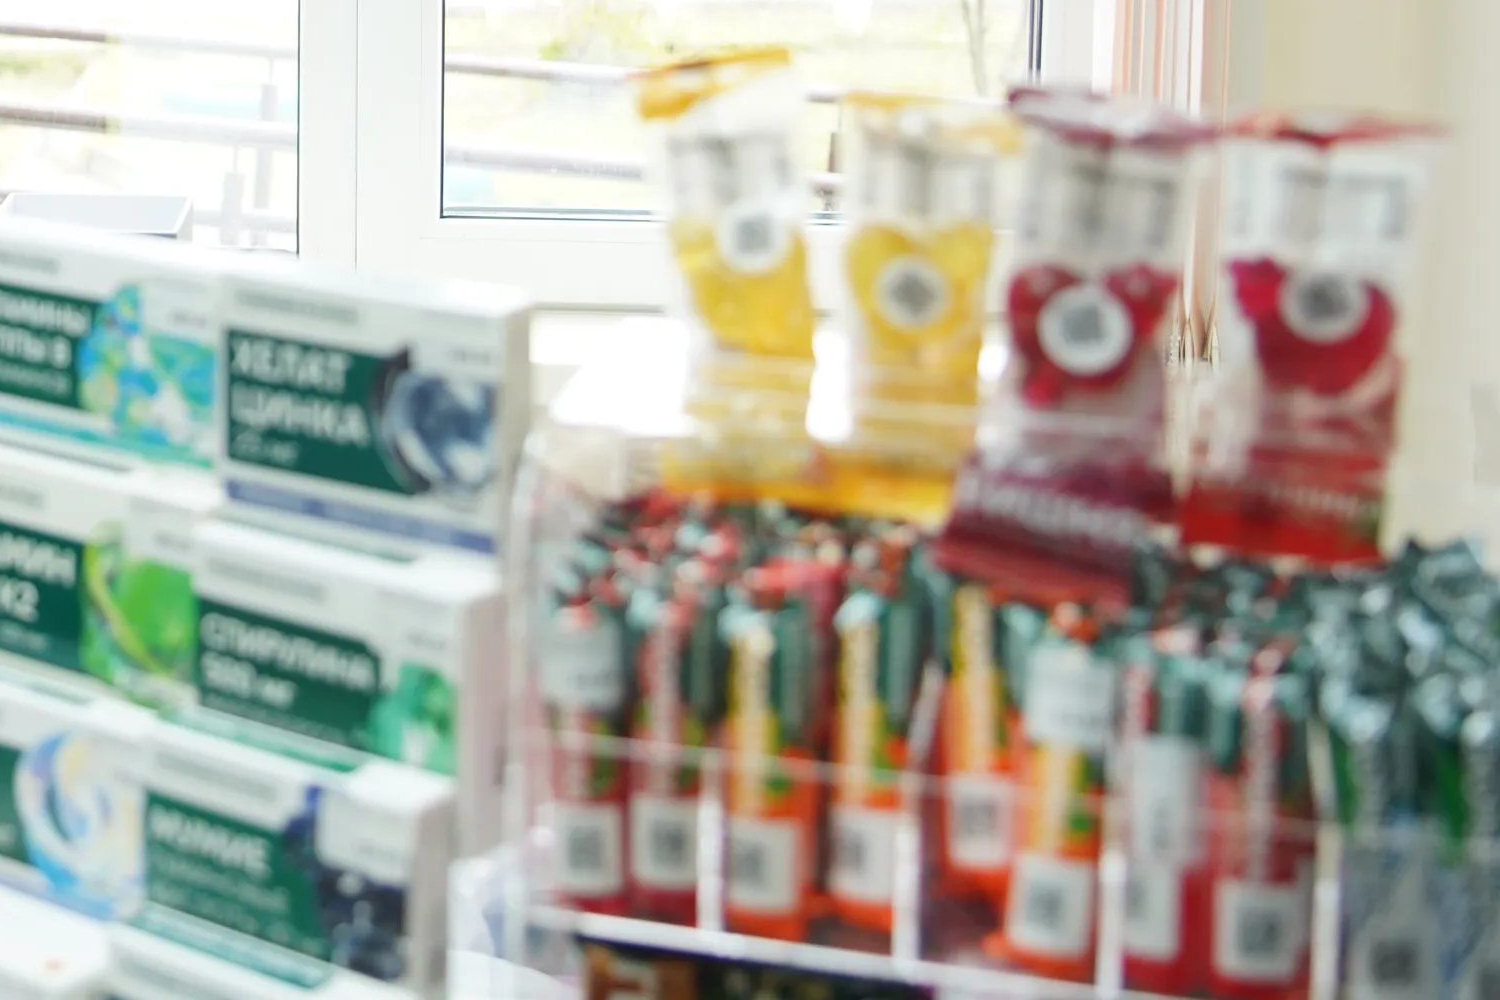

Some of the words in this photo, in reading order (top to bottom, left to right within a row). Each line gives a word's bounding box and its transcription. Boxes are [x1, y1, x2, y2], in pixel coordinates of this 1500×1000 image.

[231, 339, 351, 394] ХЕЛАТ
[231, 381, 371, 447] ЦИНКА
[200, 611, 376, 693] СПИРУЛИНА
